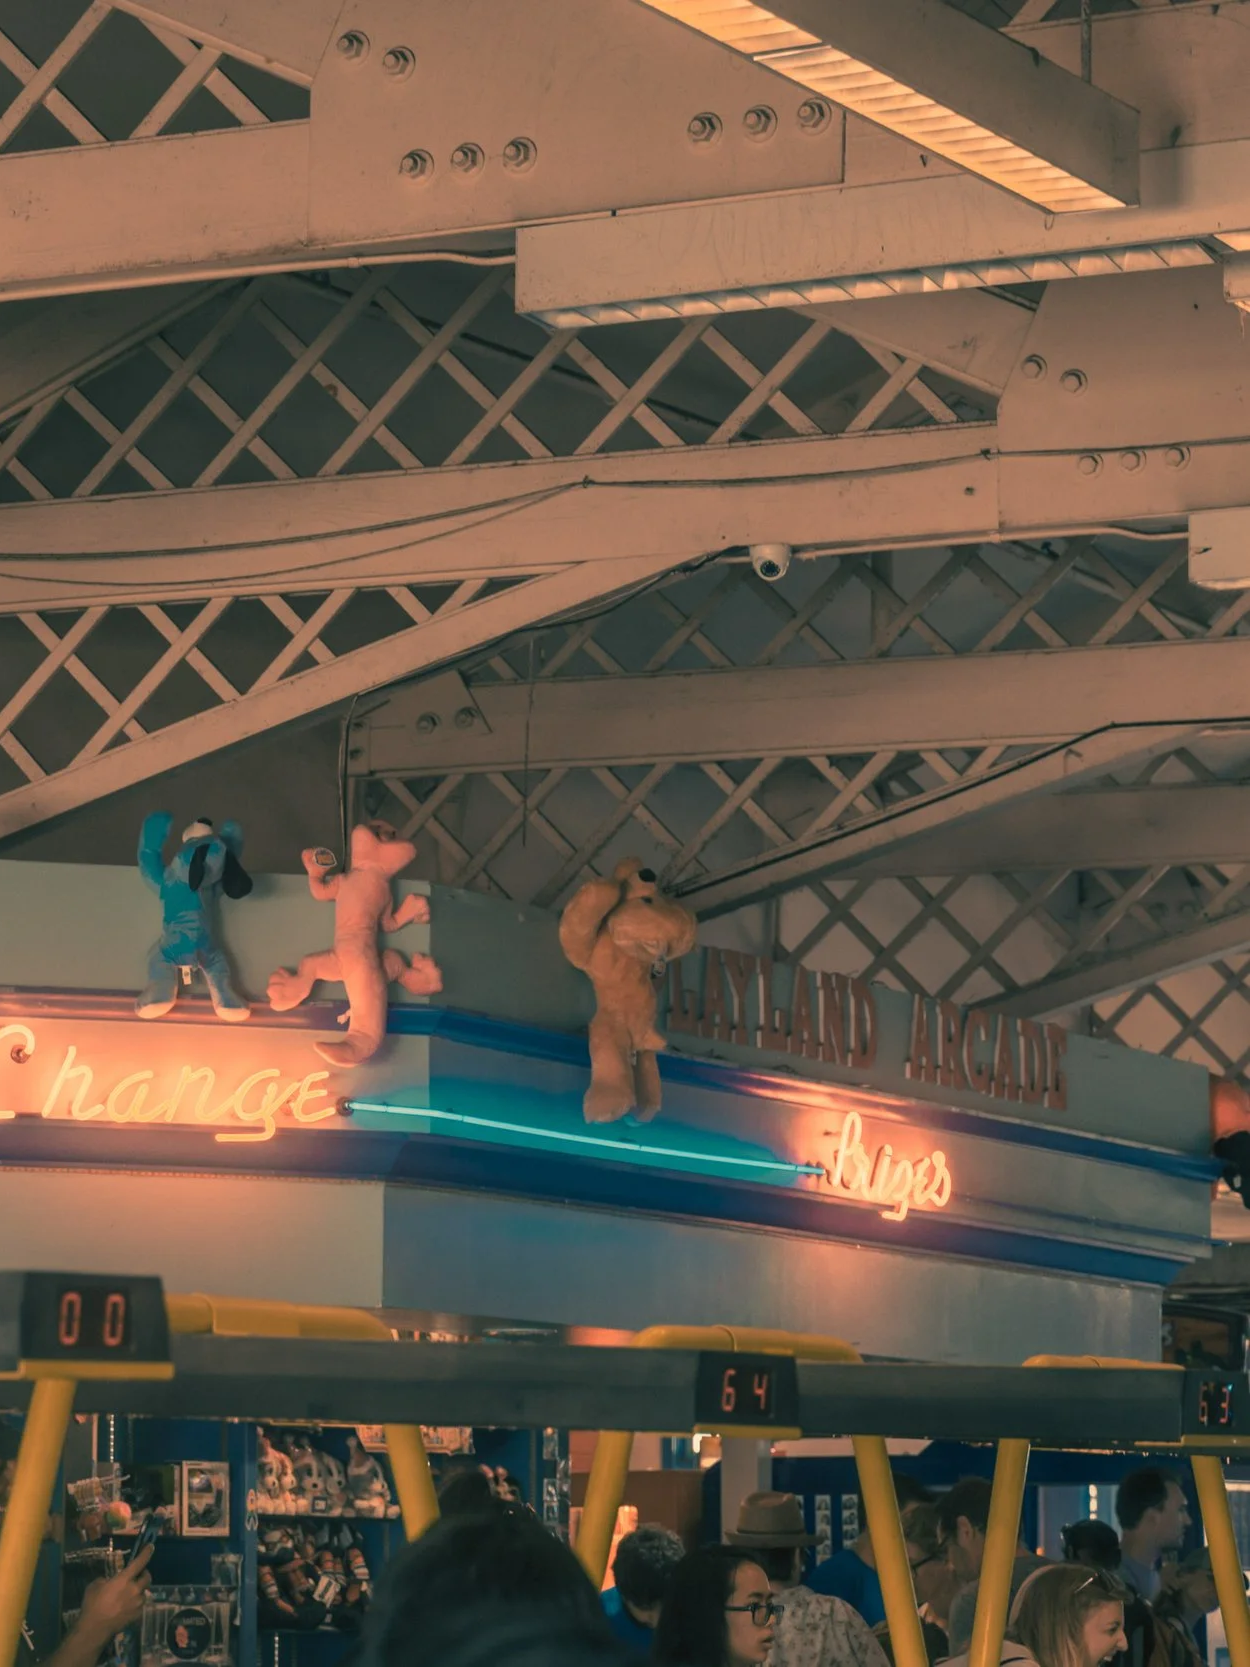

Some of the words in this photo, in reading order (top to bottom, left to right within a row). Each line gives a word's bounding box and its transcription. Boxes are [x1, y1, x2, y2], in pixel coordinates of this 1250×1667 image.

[654, 946, 877, 1069] LAYLAND
[904, 993, 1068, 1111] ARCADE
[831, 1111, 952, 1222] Prizes
[59, 1290, 126, 1347] 00
[721, 1367, 768, 1412] 64
